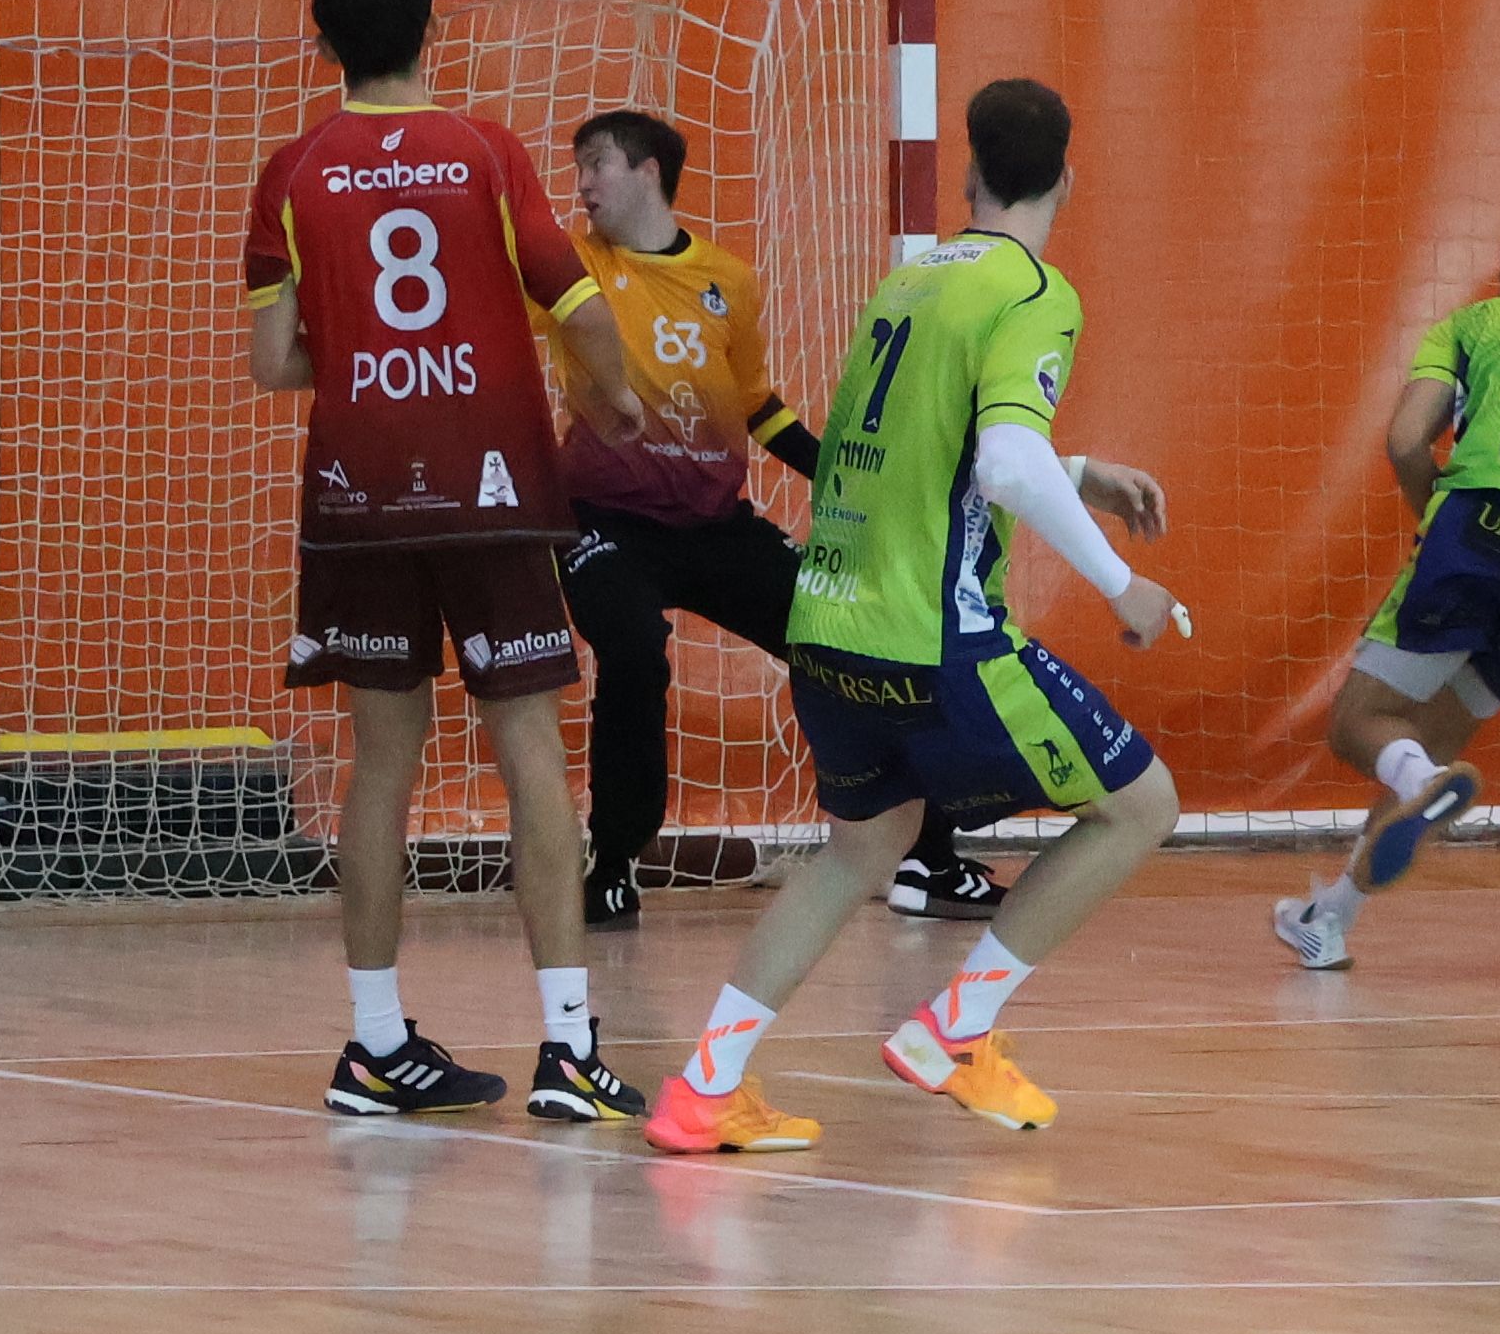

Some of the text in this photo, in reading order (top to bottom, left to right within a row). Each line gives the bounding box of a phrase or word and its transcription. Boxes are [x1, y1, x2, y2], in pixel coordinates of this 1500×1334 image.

[353, 160, 469, 191] cabero
[369, 208, 448, 331] 8
[652, 315, 707, 368] 63
[350, 342, 478, 403] PONS
[815, 506, 868, 524] OLENDUM
[325, 626, 410, 652] Zanfona
